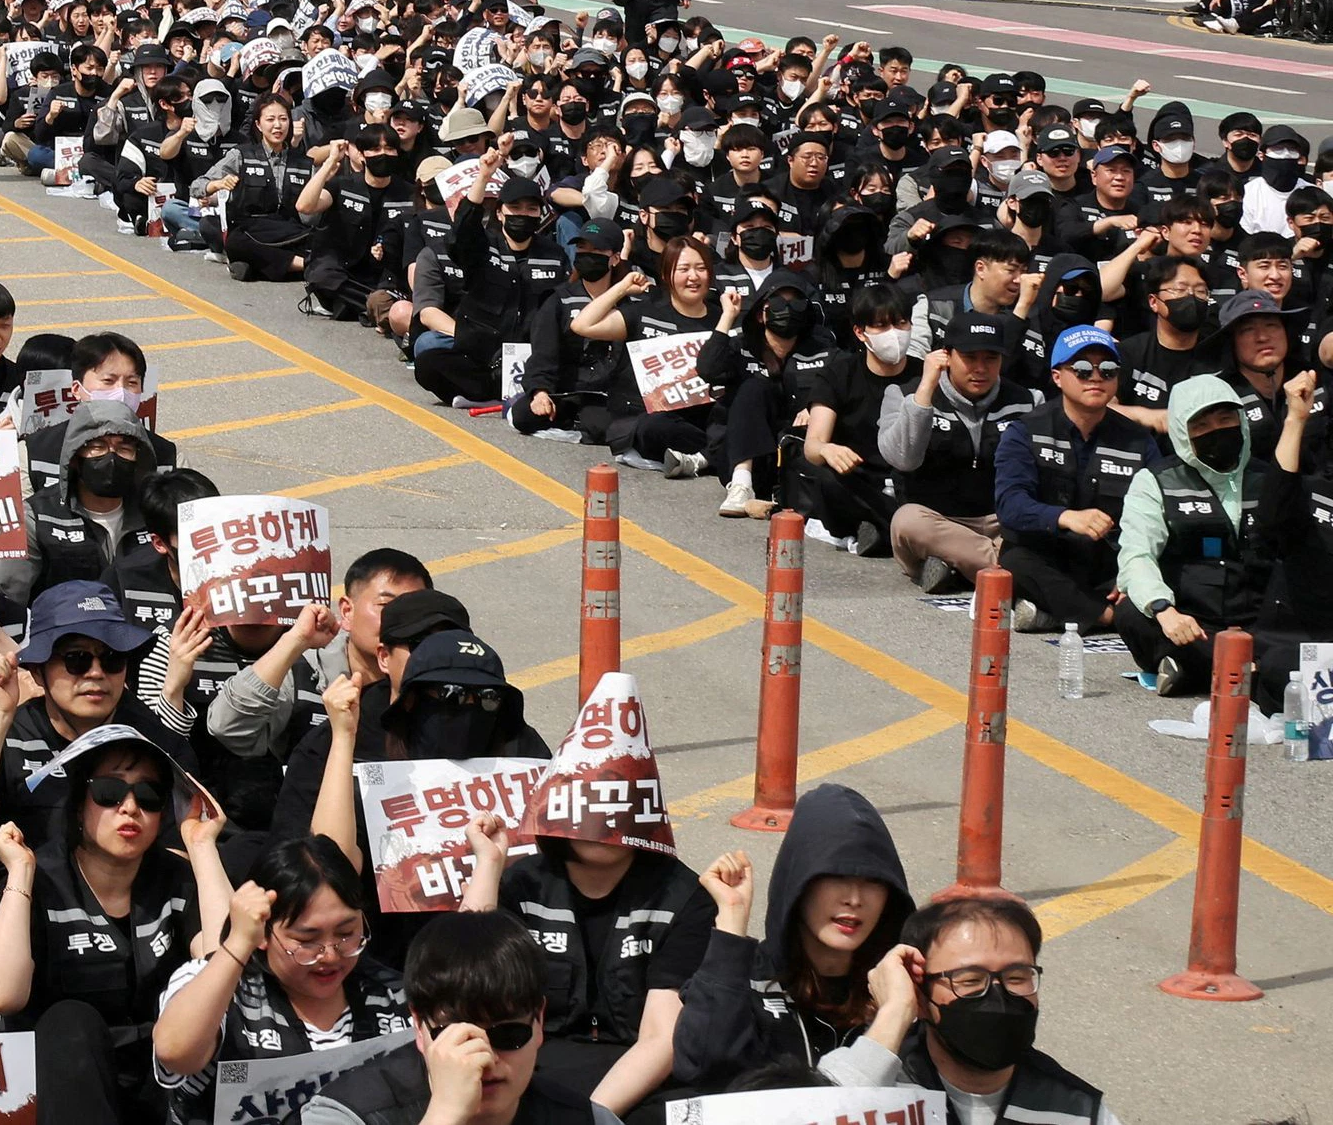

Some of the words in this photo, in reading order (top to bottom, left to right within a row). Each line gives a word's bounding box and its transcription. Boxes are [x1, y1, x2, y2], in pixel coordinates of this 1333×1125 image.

[7, 43, 54, 65] 상한폐지
[304, 52, 356, 84] 상한폐지
[245, 167, 265, 176] 투쟁
[342, 199, 364, 211] 투쟁
[779, 240, 806, 263] 하게
[531, 269, 556, 280] SELU
[970, 324, 996, 334] NSEU
[1063, 332, 1081, 345] MAKE
[1068, 338, 1089, 348] GREAT
[1133, 382, 1160, 400] 투쟁
[1039, 447, 1065, 465] 투쟁
[1100, 461, 1133, 476] SELU
[1178, 500, 1211, 515] 투쟁
[52, 526, 85, 543] 투쟁
[190, 508, 317, 564] 투명하게
[209, 569, 329, 619] 바꾸고!!!
[134, 604, 172, 624] 투쟁
[546, 777, 667, 826] 바꾸고
[67, 932, 117, 955] 투쟁
